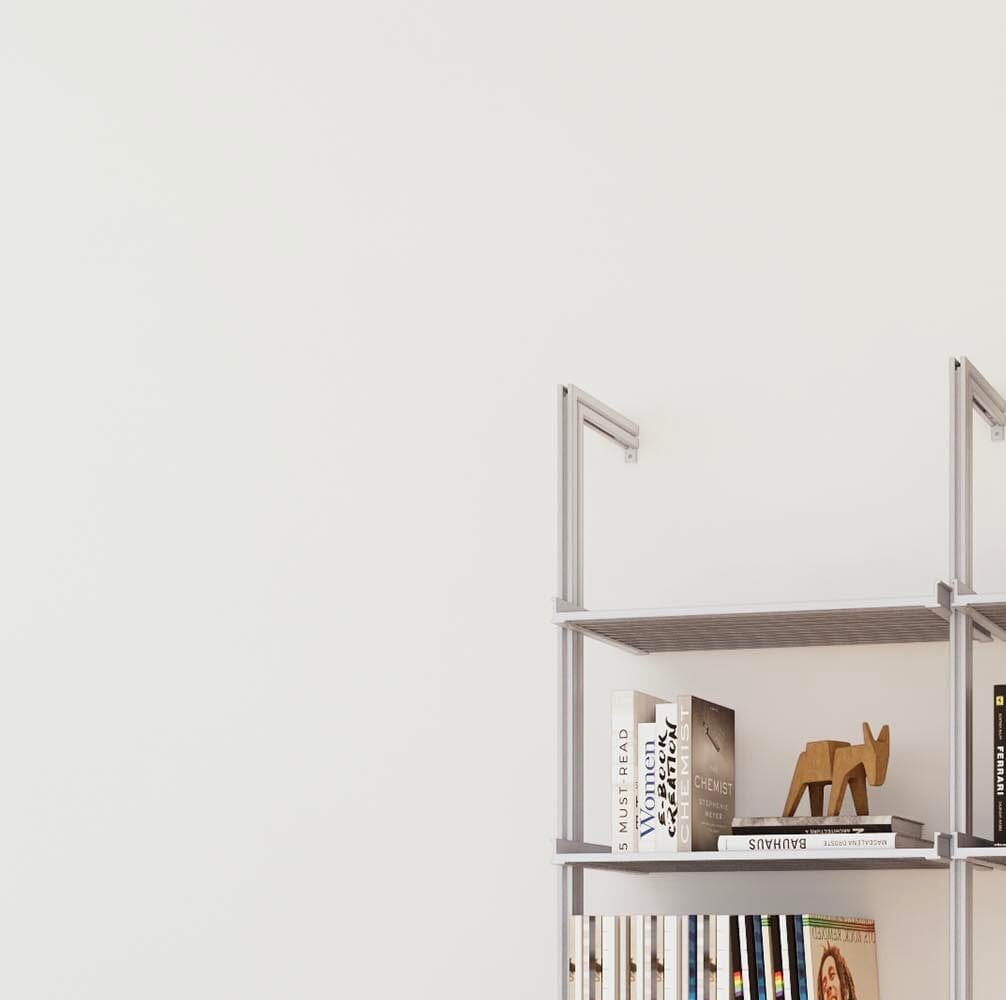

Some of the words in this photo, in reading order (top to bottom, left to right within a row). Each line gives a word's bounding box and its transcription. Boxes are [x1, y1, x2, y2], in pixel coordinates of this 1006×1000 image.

[618, 728, 628, 833] MUST-READ
[639, 739, 656, 838] Women
[657, 729, 667, 826] E-BOOK
[665, 716, 678, 838] CREATION
[680, 707, 689, 844] CHEMIST
[694, 775, 734, 796] CHEMIST
[996, 746, 1005, 795] FERRARI
[618, 843, 628, 851] 5
[748, 837, 807, 850] BAUHAUS
[823, 839, 847, 847] DROSTE
